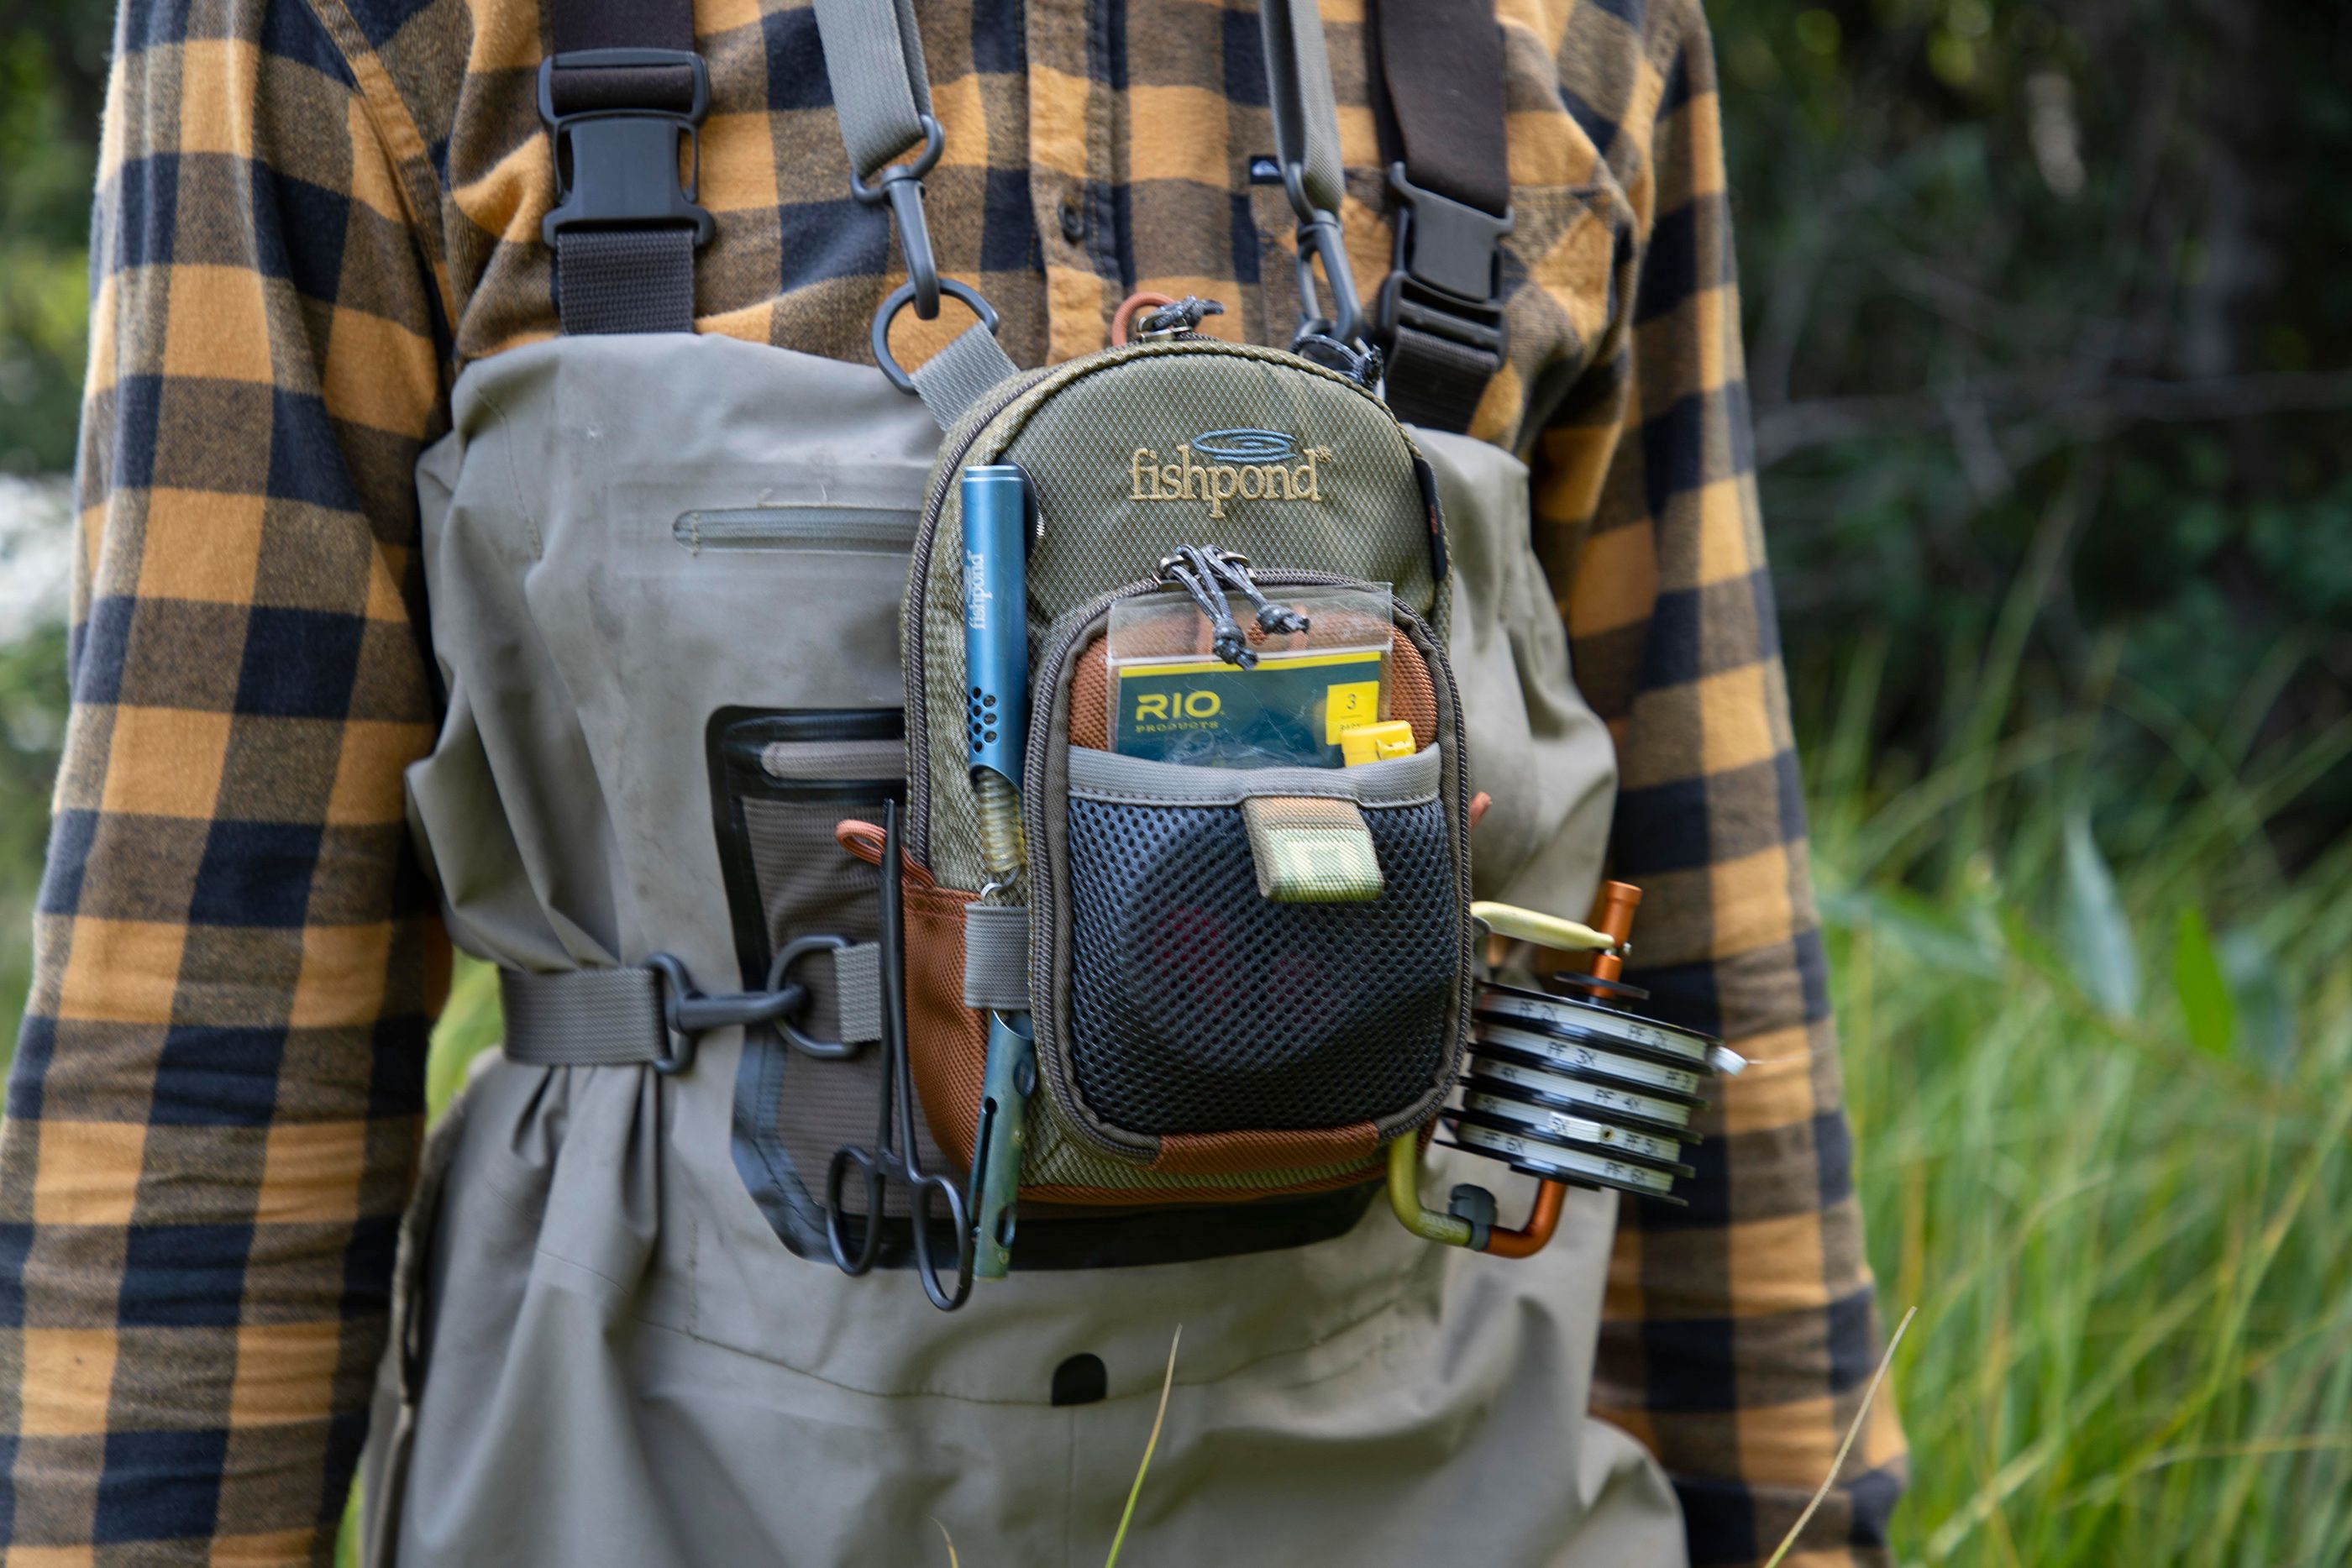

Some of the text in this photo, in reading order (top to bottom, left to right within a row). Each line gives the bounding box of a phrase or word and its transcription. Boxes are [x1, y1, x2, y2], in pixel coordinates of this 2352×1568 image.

[1129, 444, 1322, 519] fishpond
[968, 553, 993, 630] fishpond
[1136, 690, 1221, 721] RIO
[1347, 693, 1357, 711] 3
[1136, 721, 1219, 733] PRODUCTS
